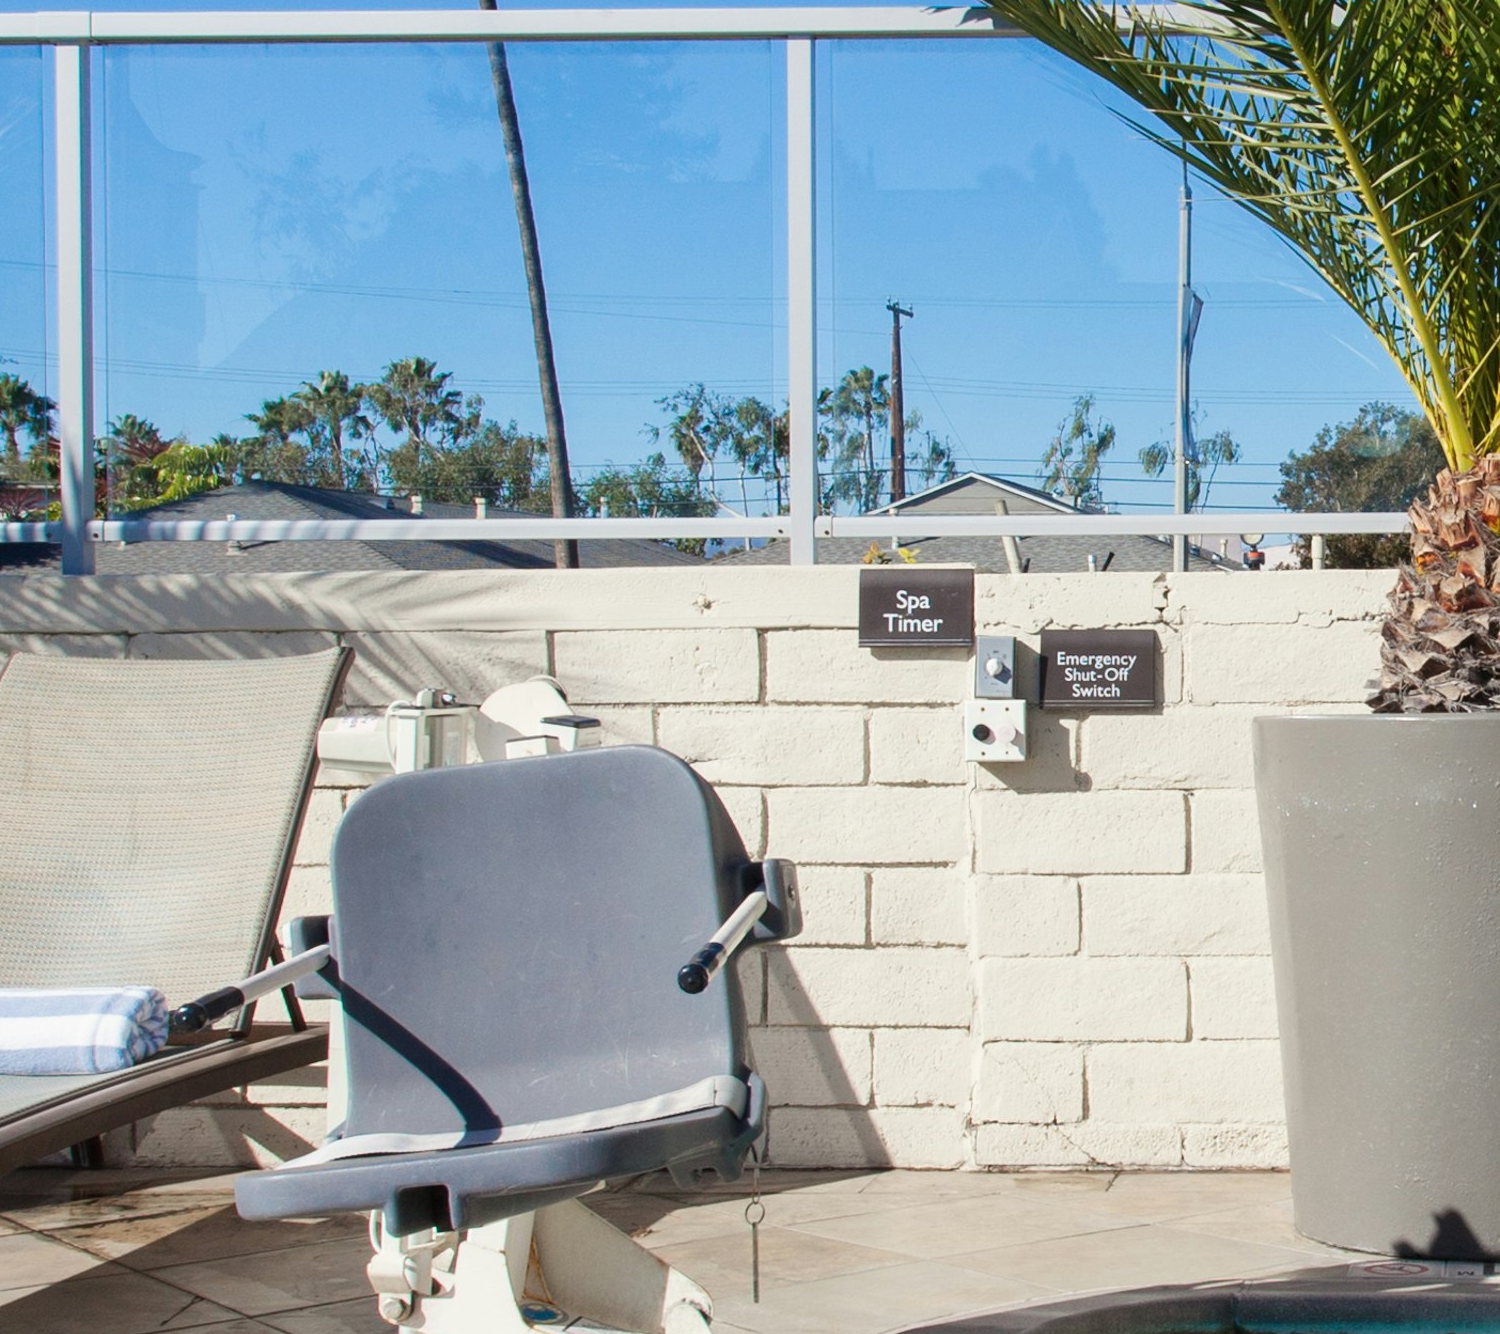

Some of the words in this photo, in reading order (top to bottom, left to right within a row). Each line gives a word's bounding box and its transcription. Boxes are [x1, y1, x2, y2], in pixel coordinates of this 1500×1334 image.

[895, 590, 931, 614] Spa
[882, 613, 944, 633] Timer
[1056, 651, 1137, 670] Emergency
[1063, 668, 1129, 683] Shut-Off
[1071, 683, 1121, 698] Switch
